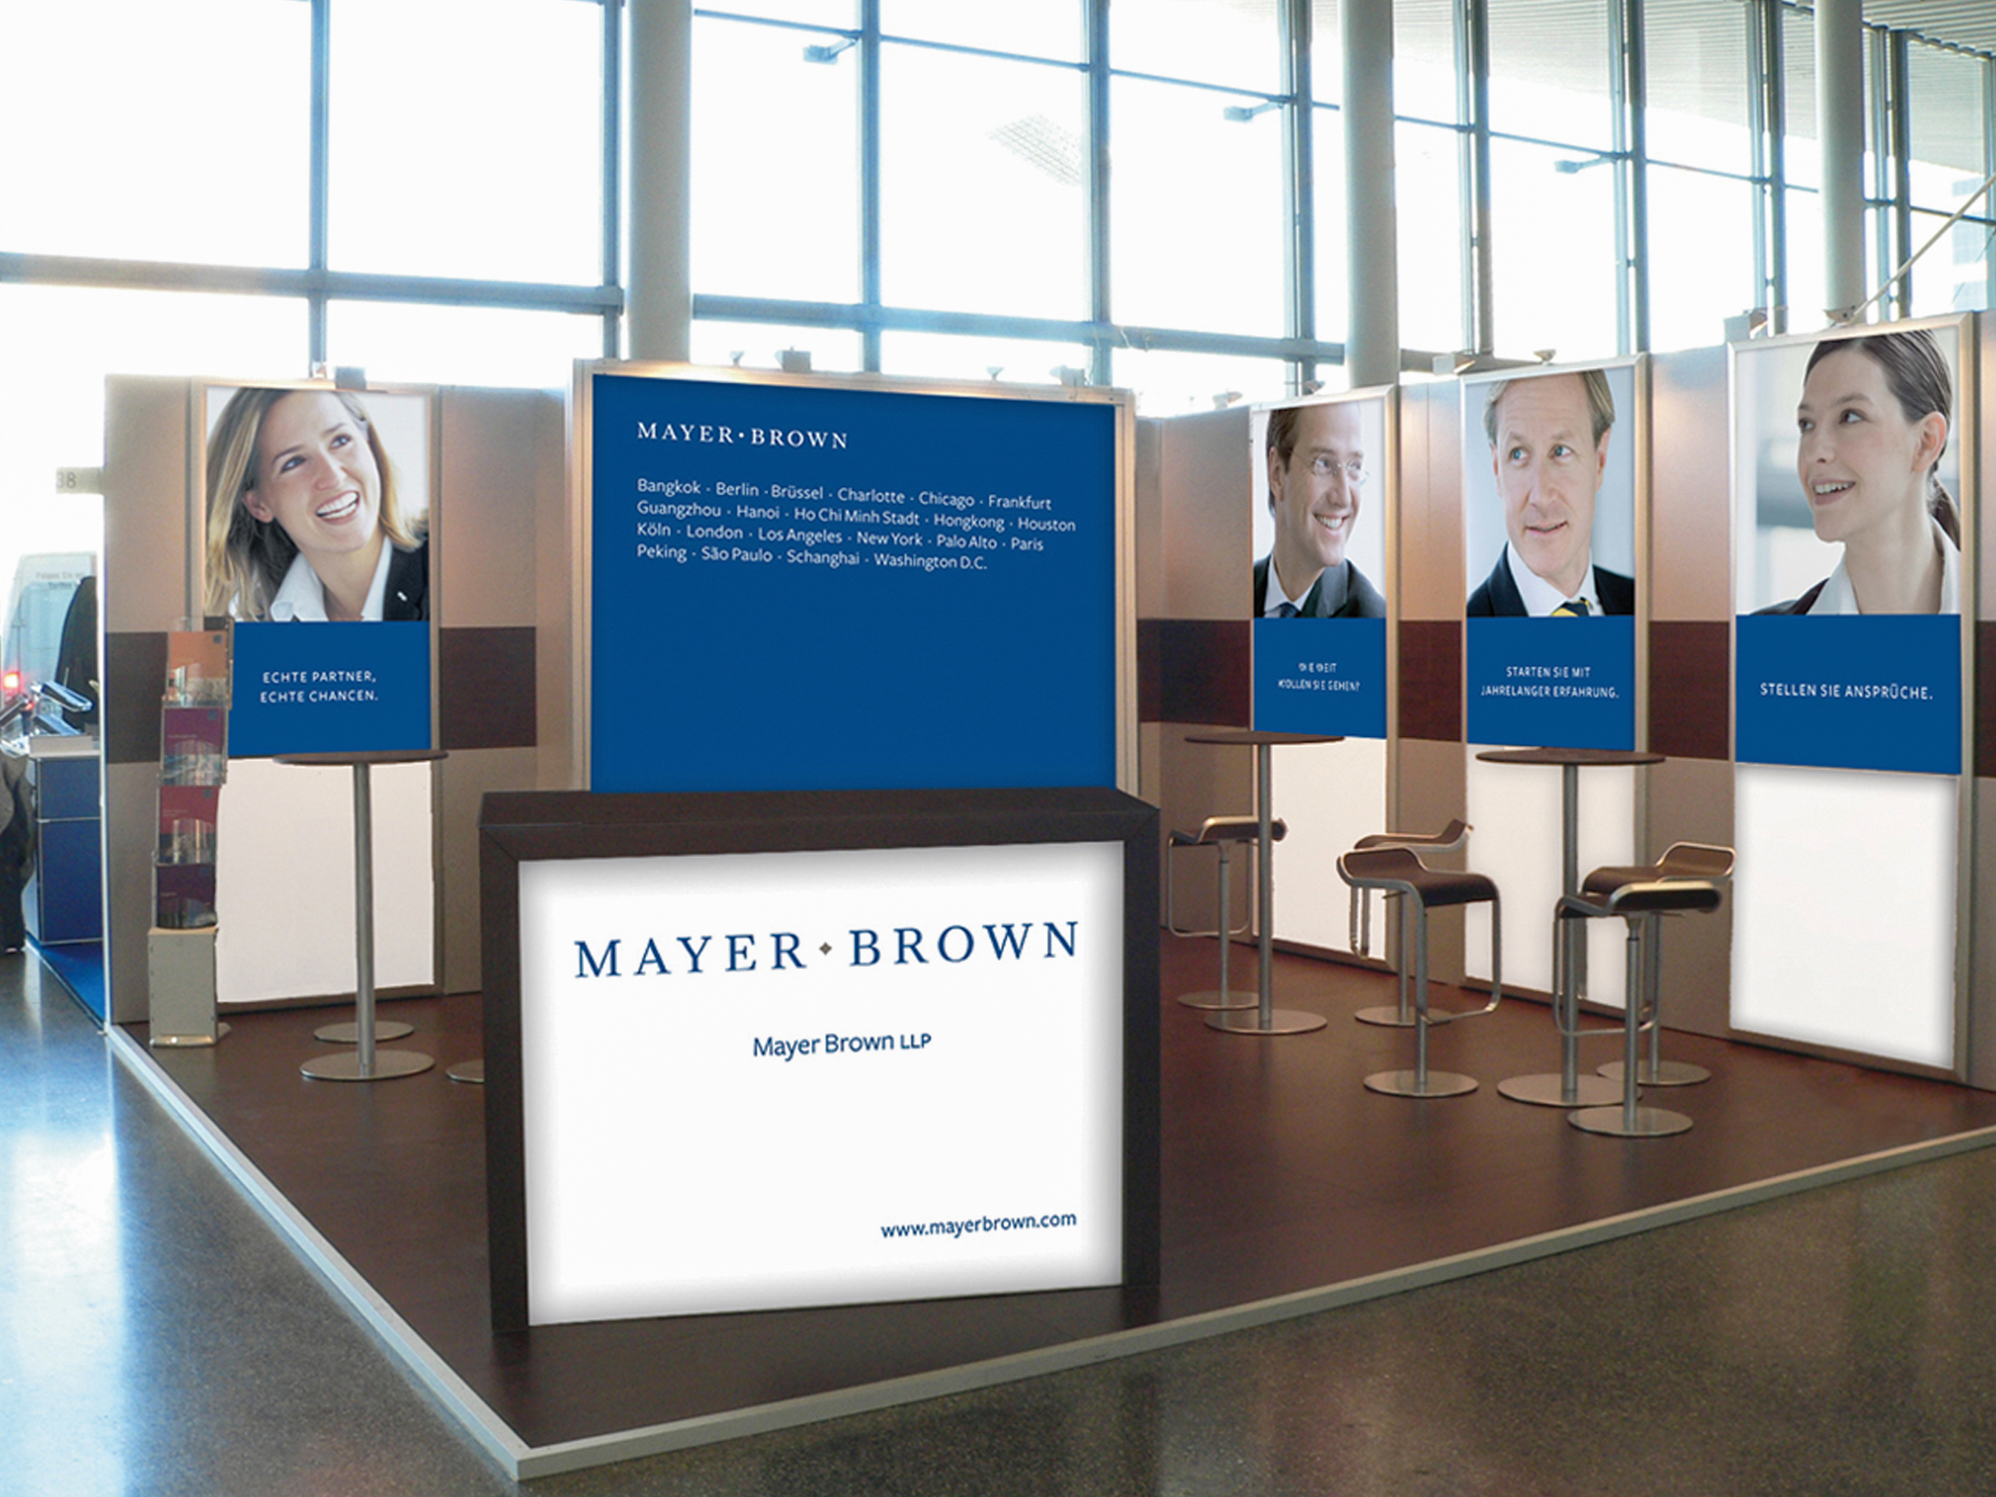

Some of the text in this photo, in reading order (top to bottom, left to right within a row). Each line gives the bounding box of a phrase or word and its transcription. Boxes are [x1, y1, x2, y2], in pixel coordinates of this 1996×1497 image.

[637, 422, 847, 449] MAYER BROWN
[637, 478, 1052, 511] Bangkok Berlin Brüssel Charlotte Chicago Frankfurt
[637, 500, 1076, 533] Guangzhou Hanoi Ho Chi Minh Stadt Hongkong Houston
[637, 522, 1044, 551] Köln London Los Angeles New York Palo Alto Paris
[637, 544, 988, 572] Peking São Paulo Schanghai Washington D.C.
[263, 670, 377, 683] ECHTE PARTNER,
[1506, 666, 1591, 678] STARTEN SIE MIT
[260, 689, 379, 703] ECHTE CHANCEN.
[1481, 685, 1620, 699] JAHRELANGER ERFAHRUNG.
[1760, 682, 1934, 700] STELLEN SIE ANSPRÜCHE.
[574, 921, 1078, 979] MAYER BROWN
[753, 1032, 931, 1062] Mayer Brown LLP
[881, 1213, 1077, 1239] www.mayerbrown.com
